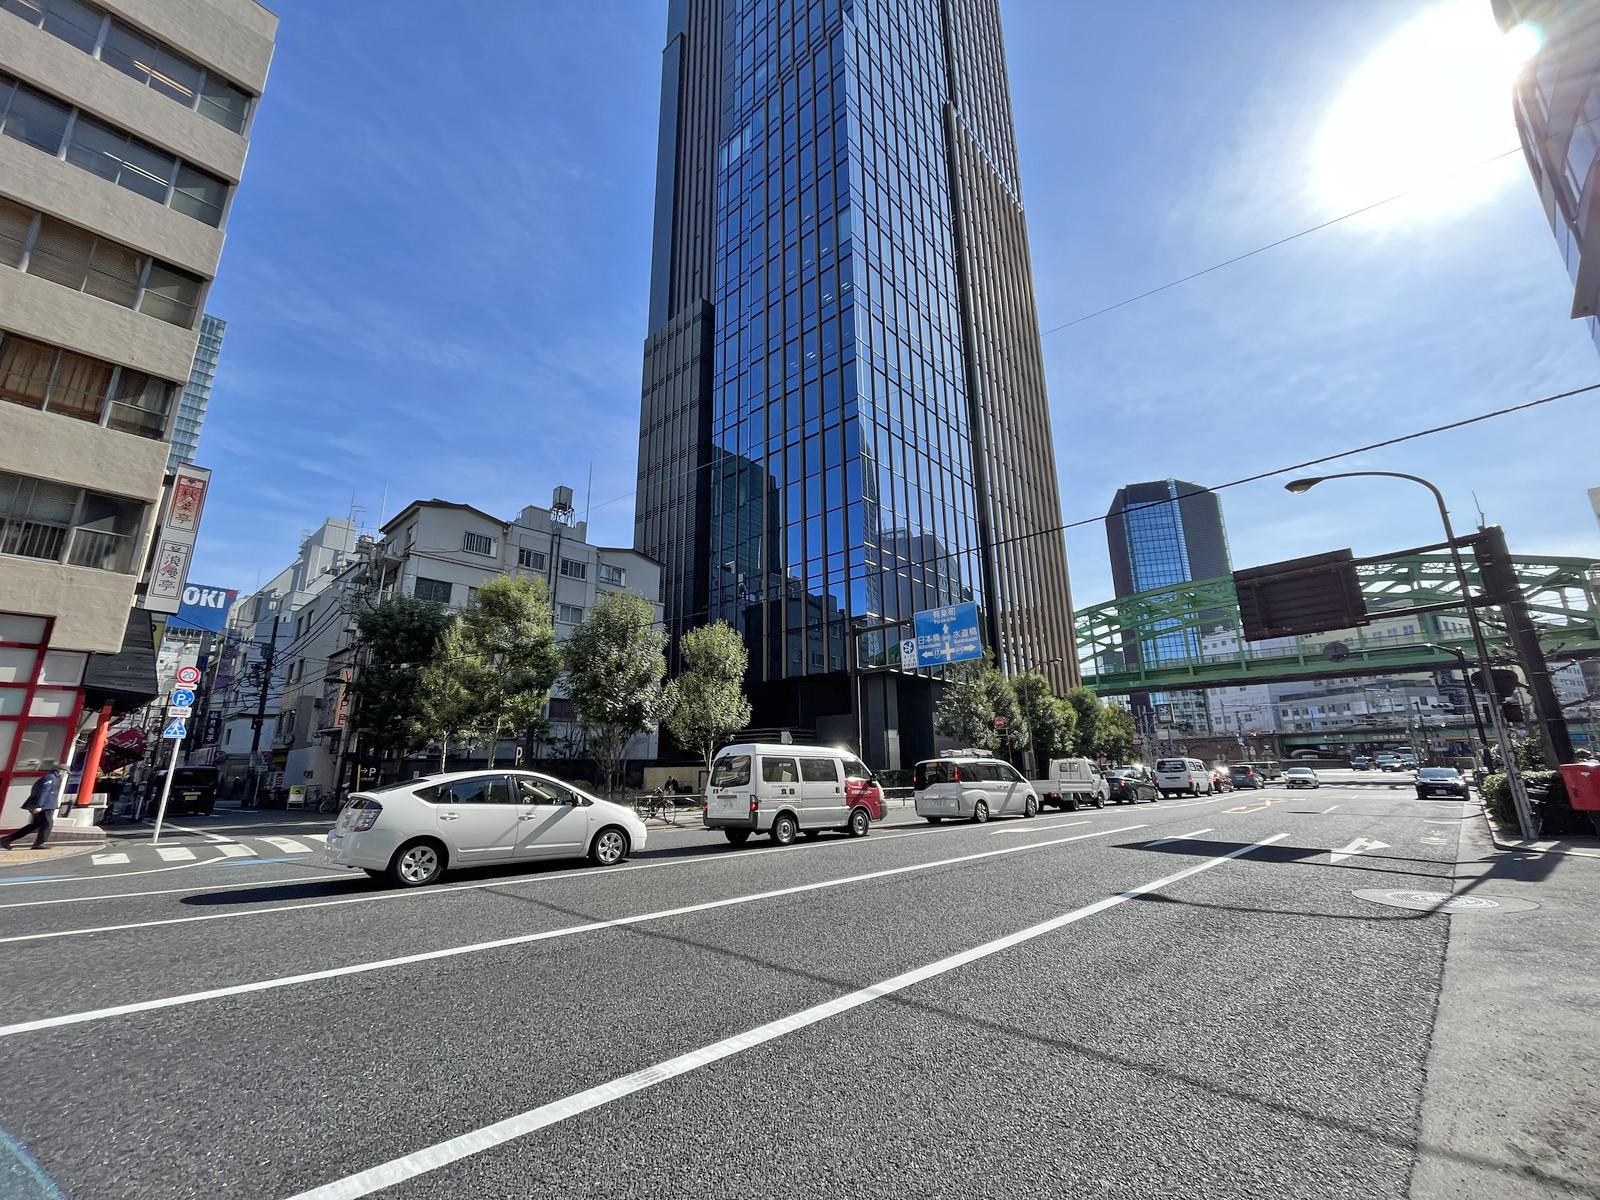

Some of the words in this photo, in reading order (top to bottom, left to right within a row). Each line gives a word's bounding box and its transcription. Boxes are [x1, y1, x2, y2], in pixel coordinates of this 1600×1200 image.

[182, 586, 227, 609] OKI
[933, 607, 956, 619] 有楽町
[918, 633, 940, 645] 日本橋
[182, 670, 195, 680] 20
[176, 693, 186, 704] P
[515, 746, 523, 766] P
[369, 767, 377, 777] P
